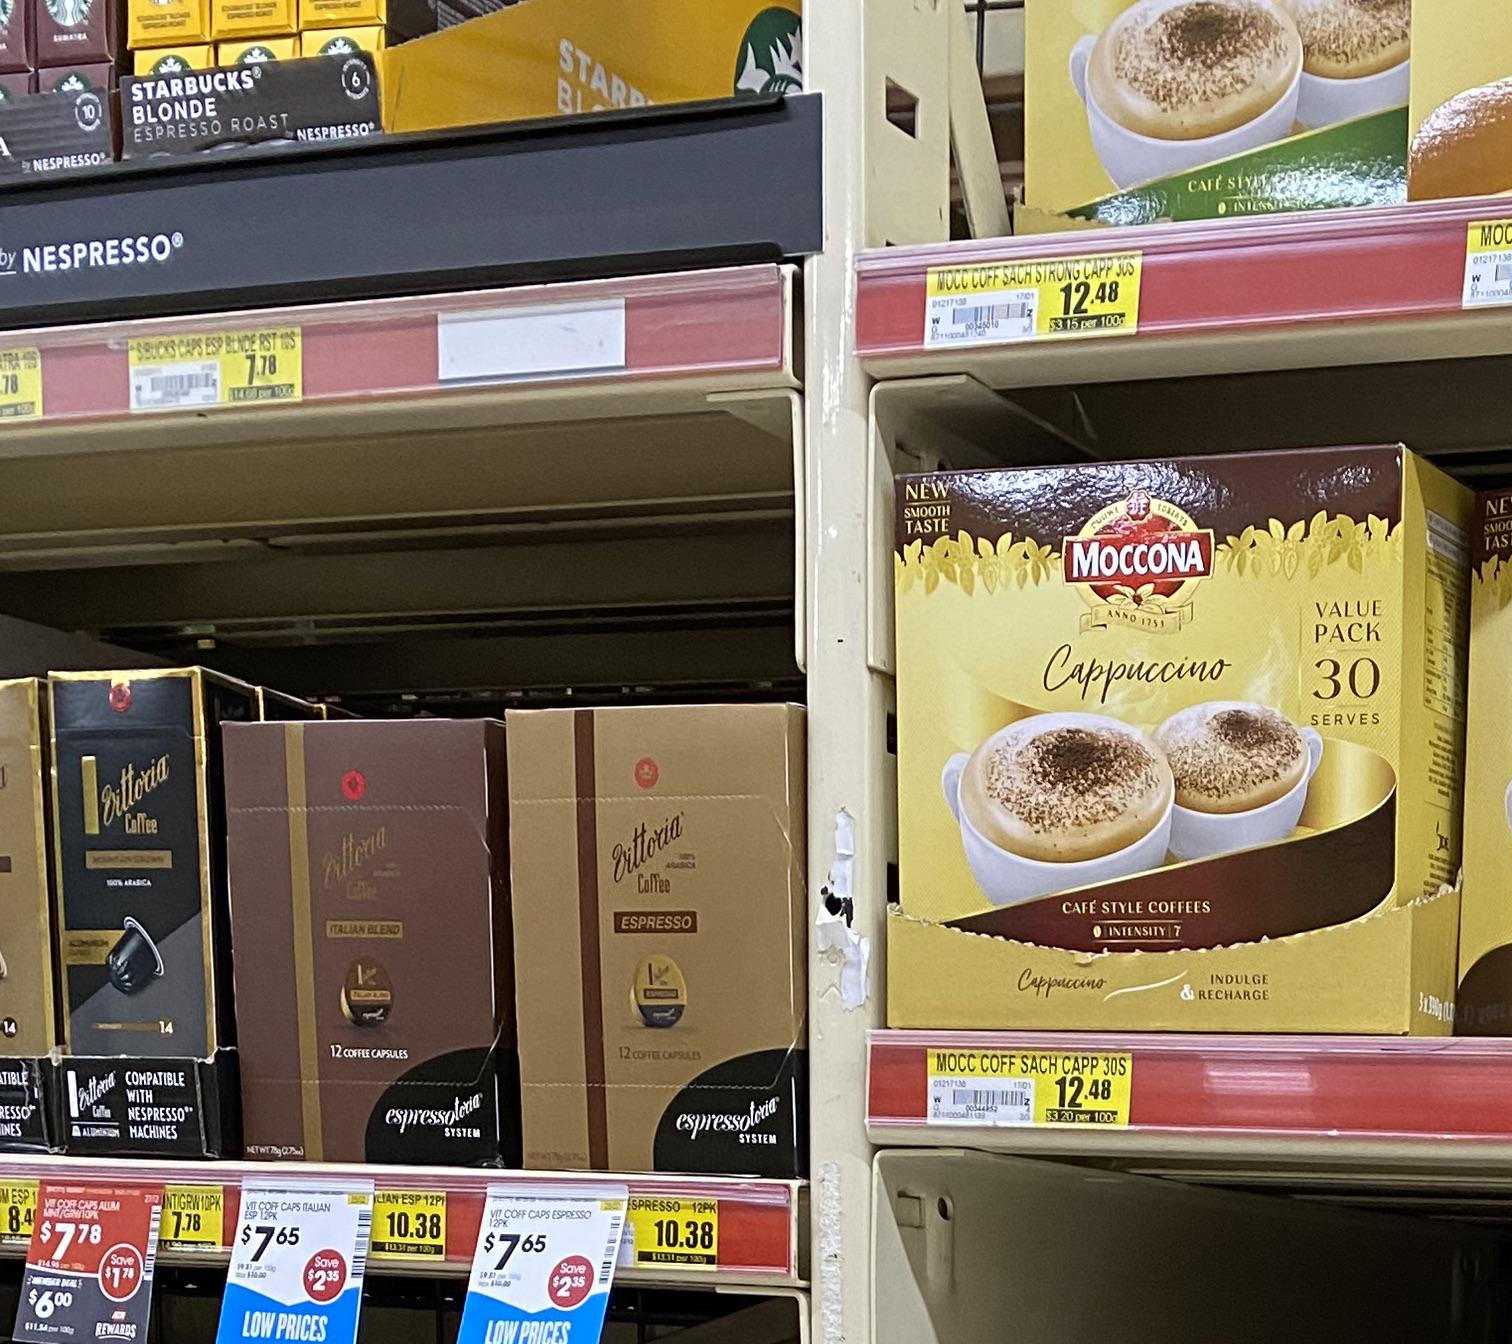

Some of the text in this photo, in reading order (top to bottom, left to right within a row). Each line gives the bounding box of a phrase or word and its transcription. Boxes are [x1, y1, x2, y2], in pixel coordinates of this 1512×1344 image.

[133, 98, 217, 125] BLONDE
[134, 114, 288, 143] ESPRESSO ROAST
[1072, 540, 1205, 578] MOCCONA
[1043, 644, 1232, 704] Cappuccino
[638, 874, 670, 894] Coffee
[1062, 899, 1211, 915] CAFÉ STYLE COFFEES
[621, 915, 693, 930] ESPRESSO
[125, 1071, 186, 1087] COMPATIBLE
[127, 1089, 154, 1104] WITH
[130, 1123, 178, 1140] MACHINES
[739, 1132, 777, 1145] SYSTEM
[387, 1212, 441, 1239] 10.38
[655, 1220, 714, 1250] 10.38
[243, 1311, 328, 1342] LOW PRICES
